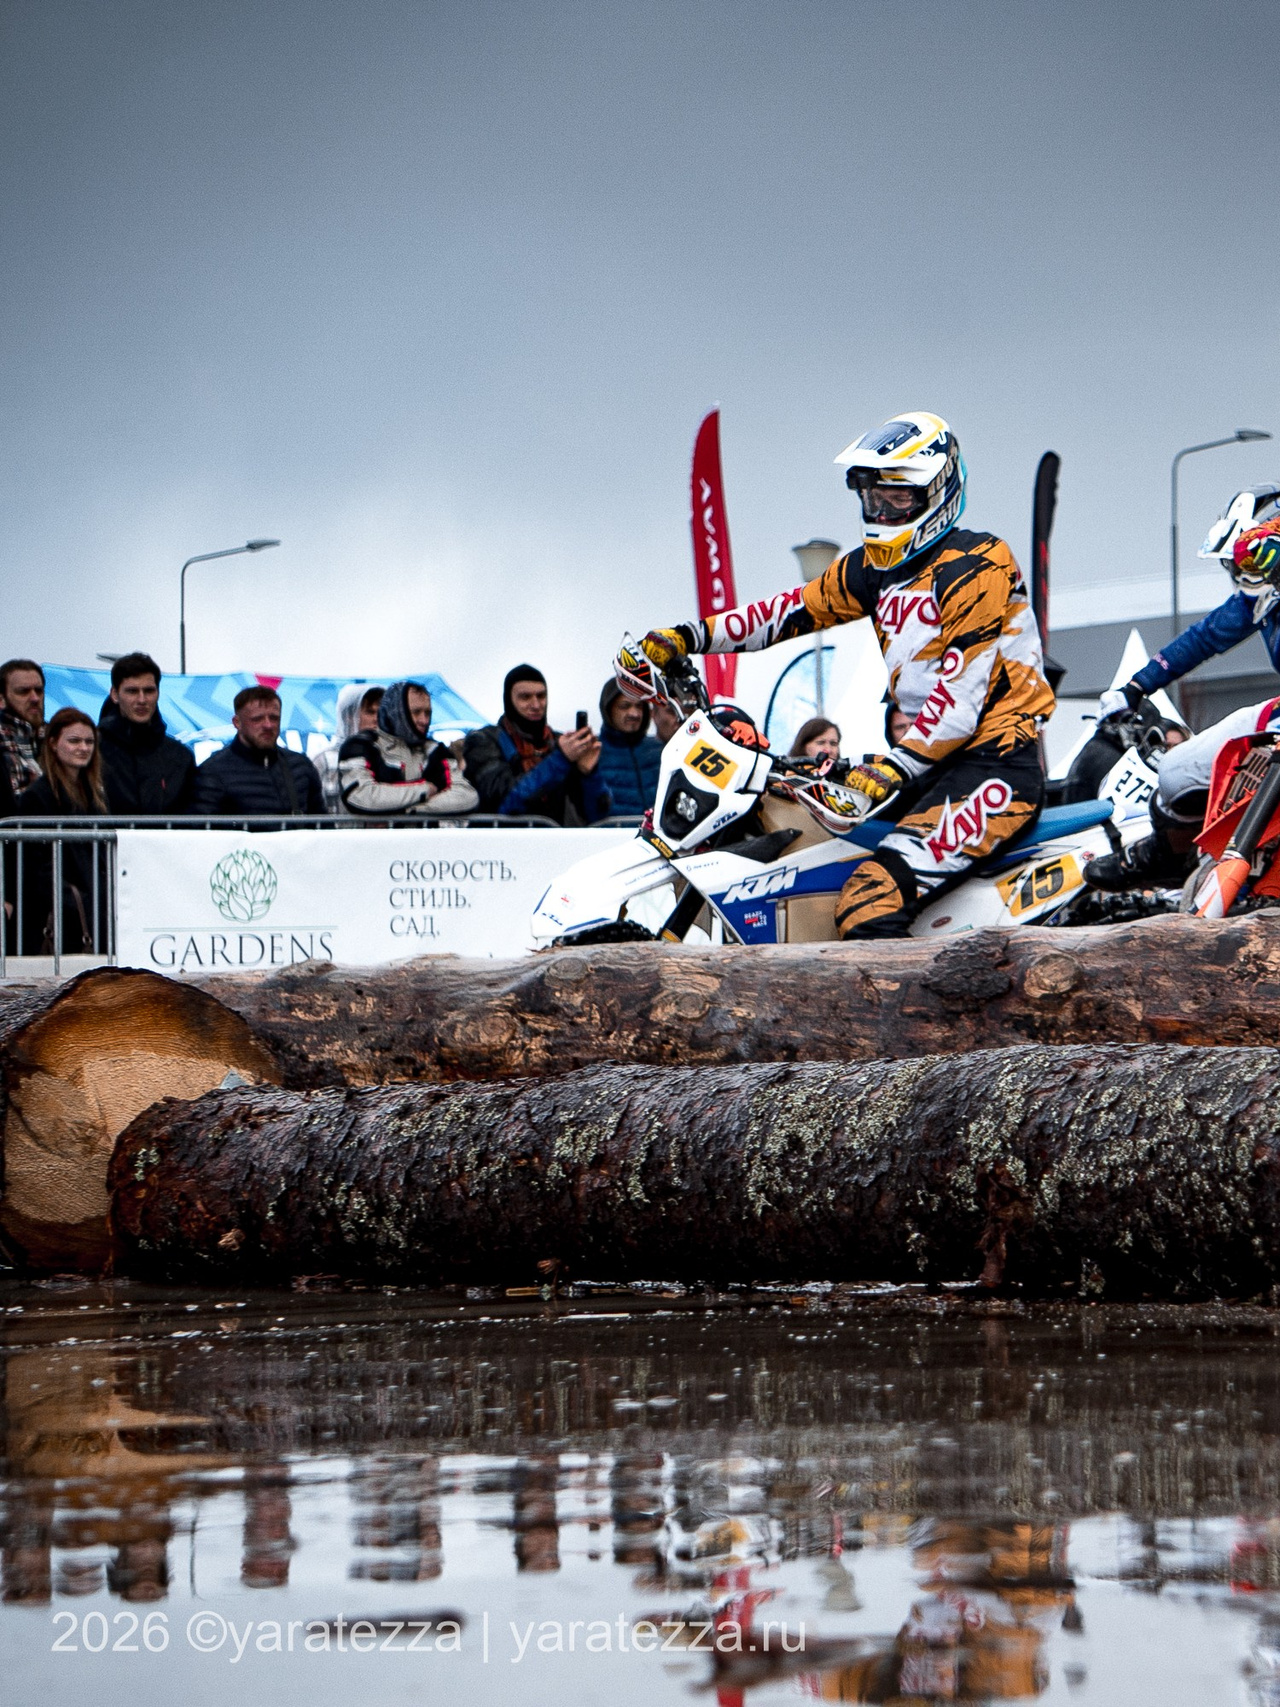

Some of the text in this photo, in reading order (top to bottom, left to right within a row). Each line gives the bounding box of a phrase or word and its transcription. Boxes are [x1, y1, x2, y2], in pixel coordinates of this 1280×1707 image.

[914, 651, 959, 738] KAYO
[691, 746, 730, 777] 15
[1115, 770, 1153, 804] 272
[927, 783, 1007, 863] KAYO
[389, 860, 516, 882] СКОРОСТЬ.
[722, 865, 798, 904] KTM
[1007, 859, 1064, 910] 15
[389, 887, 471, 909] СТИЛЬ.
[390, 915, 440, 938] САД.
[150, 932, 333, 967] GARDENS
